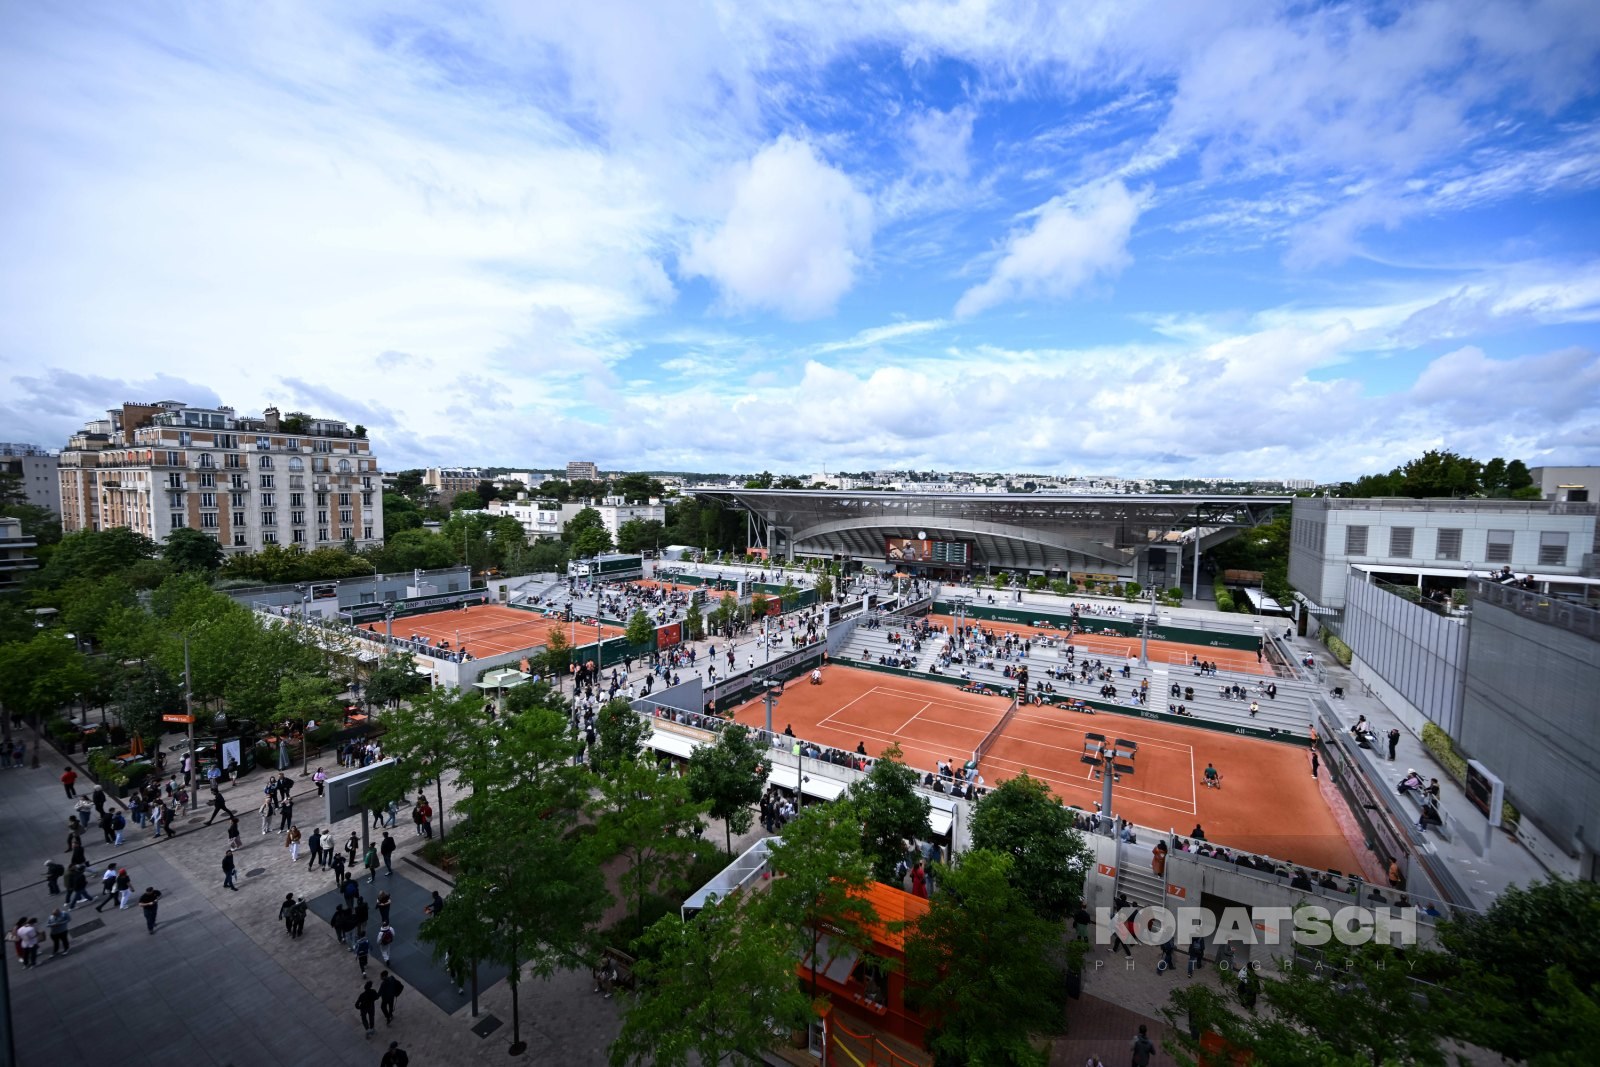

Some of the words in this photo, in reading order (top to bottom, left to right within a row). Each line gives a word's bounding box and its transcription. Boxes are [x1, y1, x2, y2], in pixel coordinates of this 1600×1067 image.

[424, 597, 450, 606] PARIBAS
[1105, 866, 1112, 875] 7
[1174, 887, 1182, 895] 7
